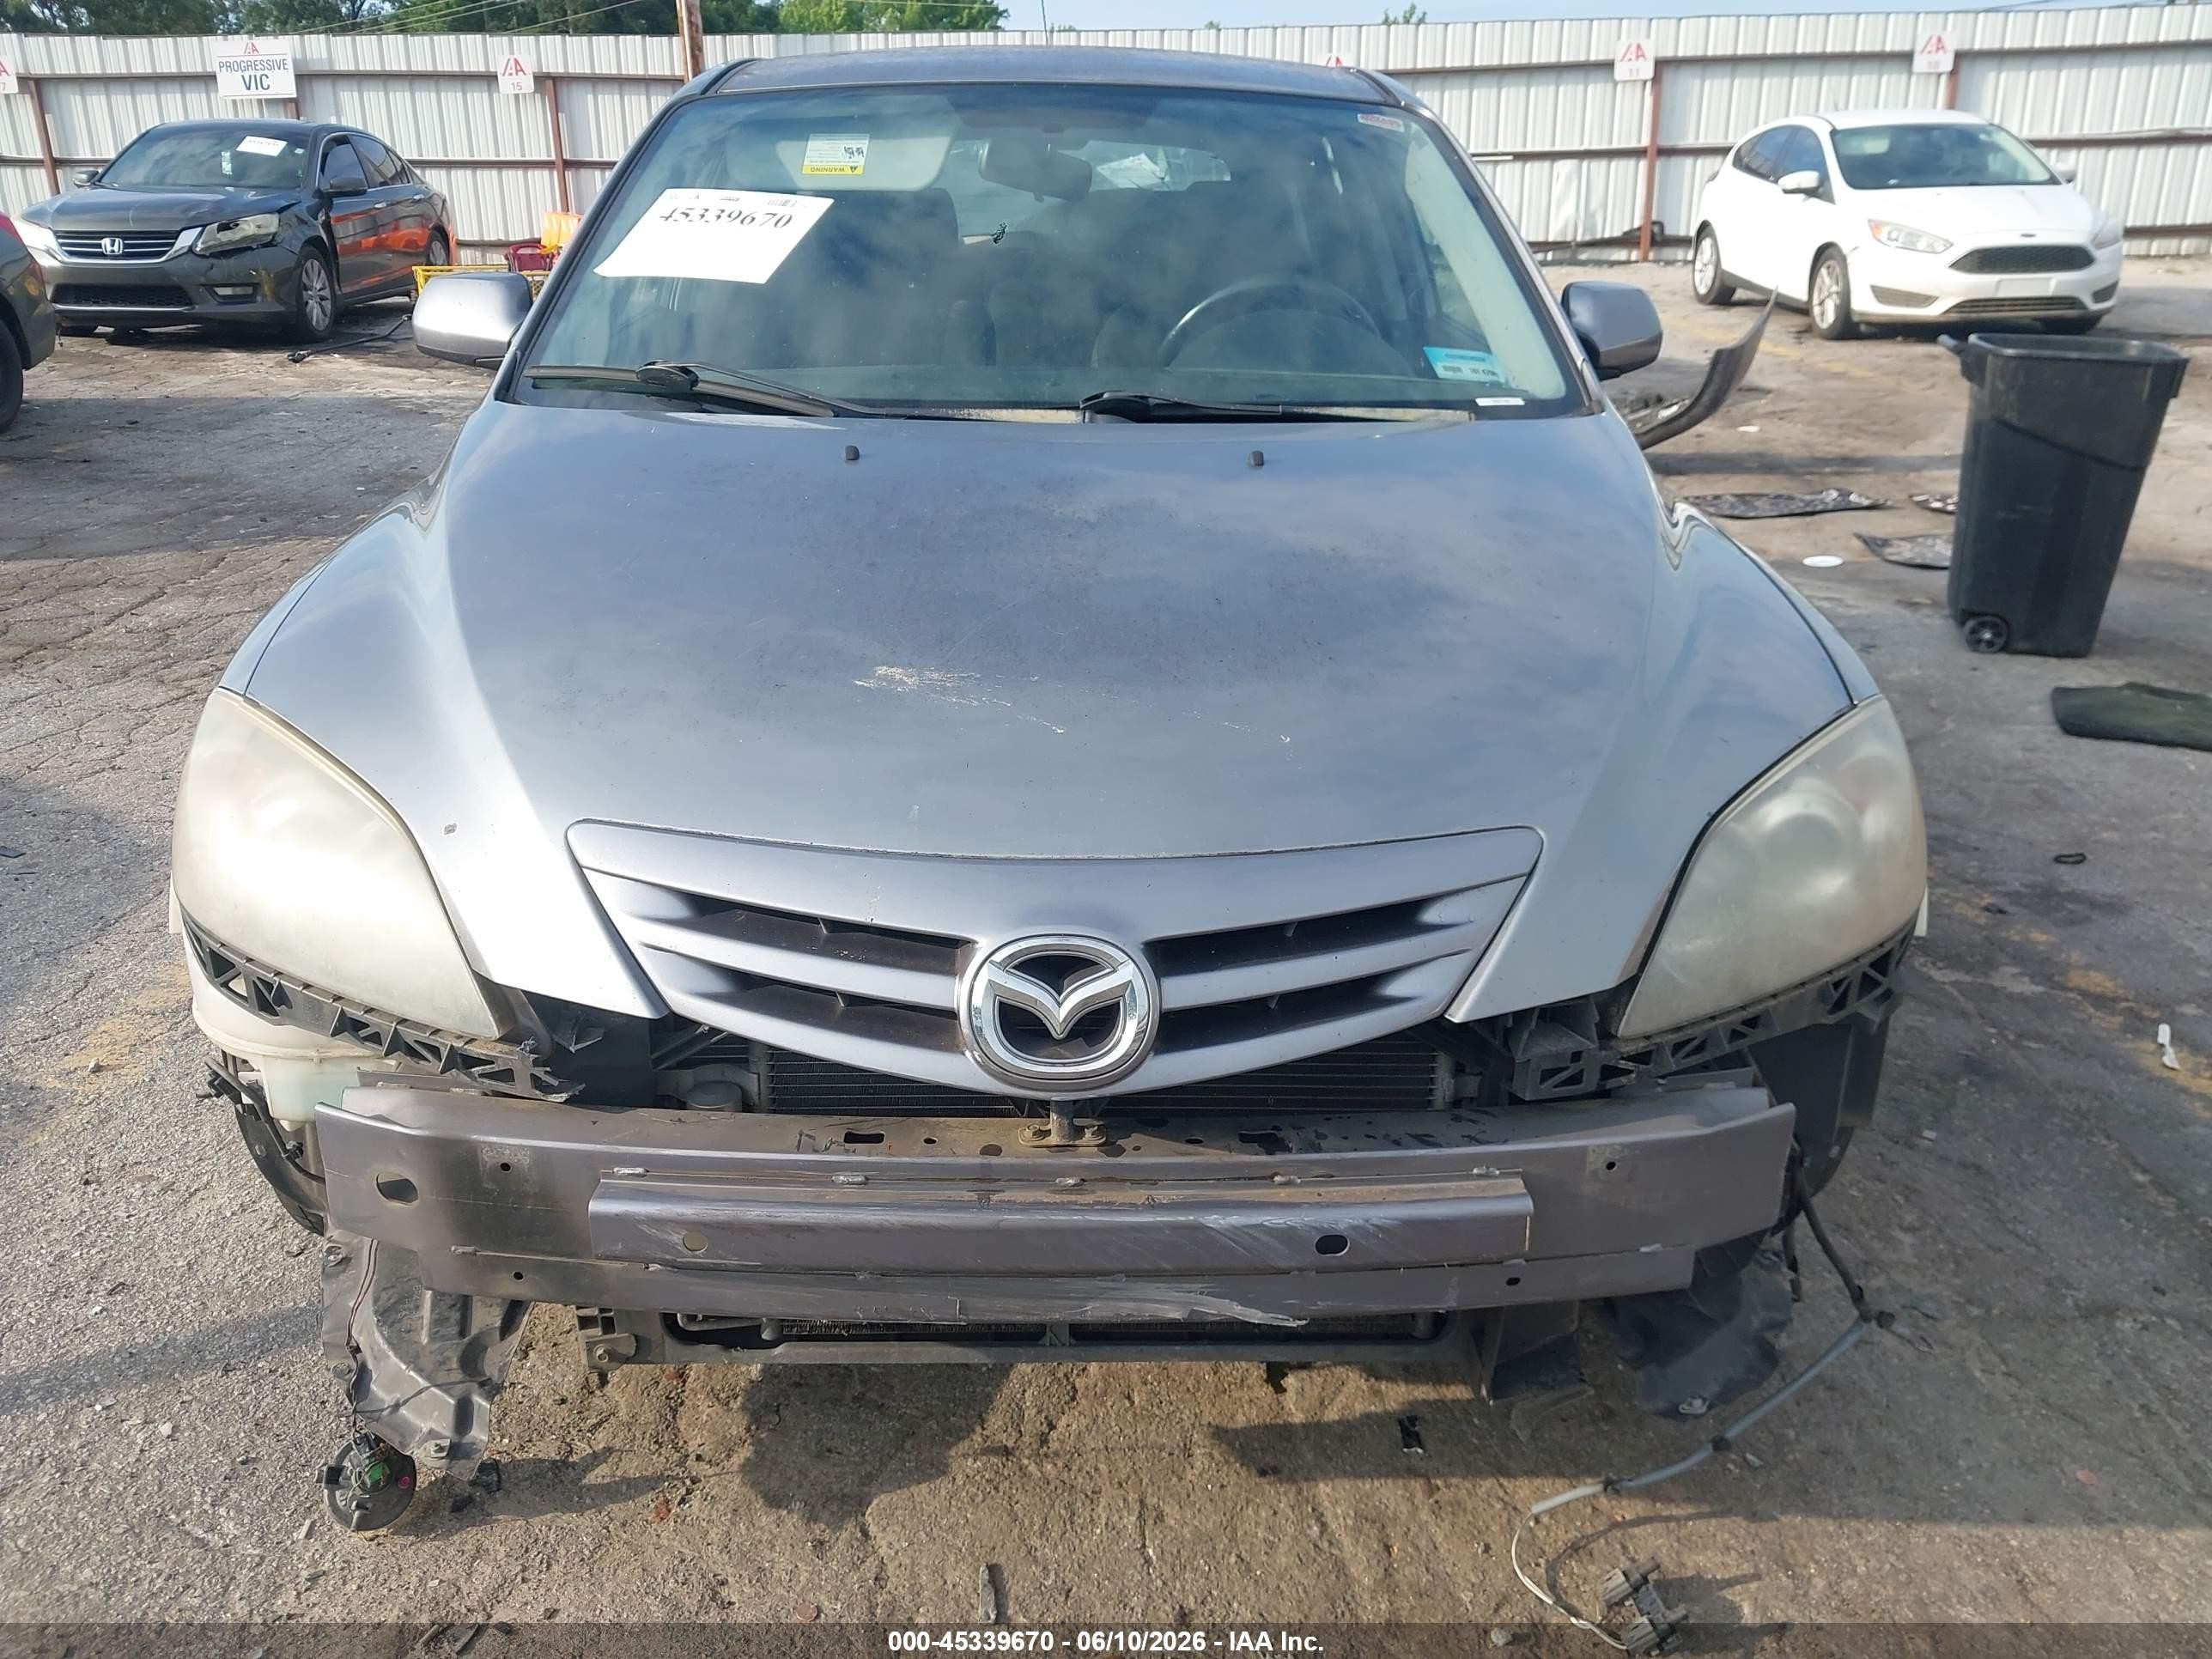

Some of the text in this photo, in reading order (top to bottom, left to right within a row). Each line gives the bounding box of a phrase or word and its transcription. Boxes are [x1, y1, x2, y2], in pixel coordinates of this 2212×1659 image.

[218, 58, 289, 73] PROGRESSIVE
[241, 74, 270, 91] VIC
[510, 82, 523, 91] 15
[659, 207, 793, 228] 45339670
